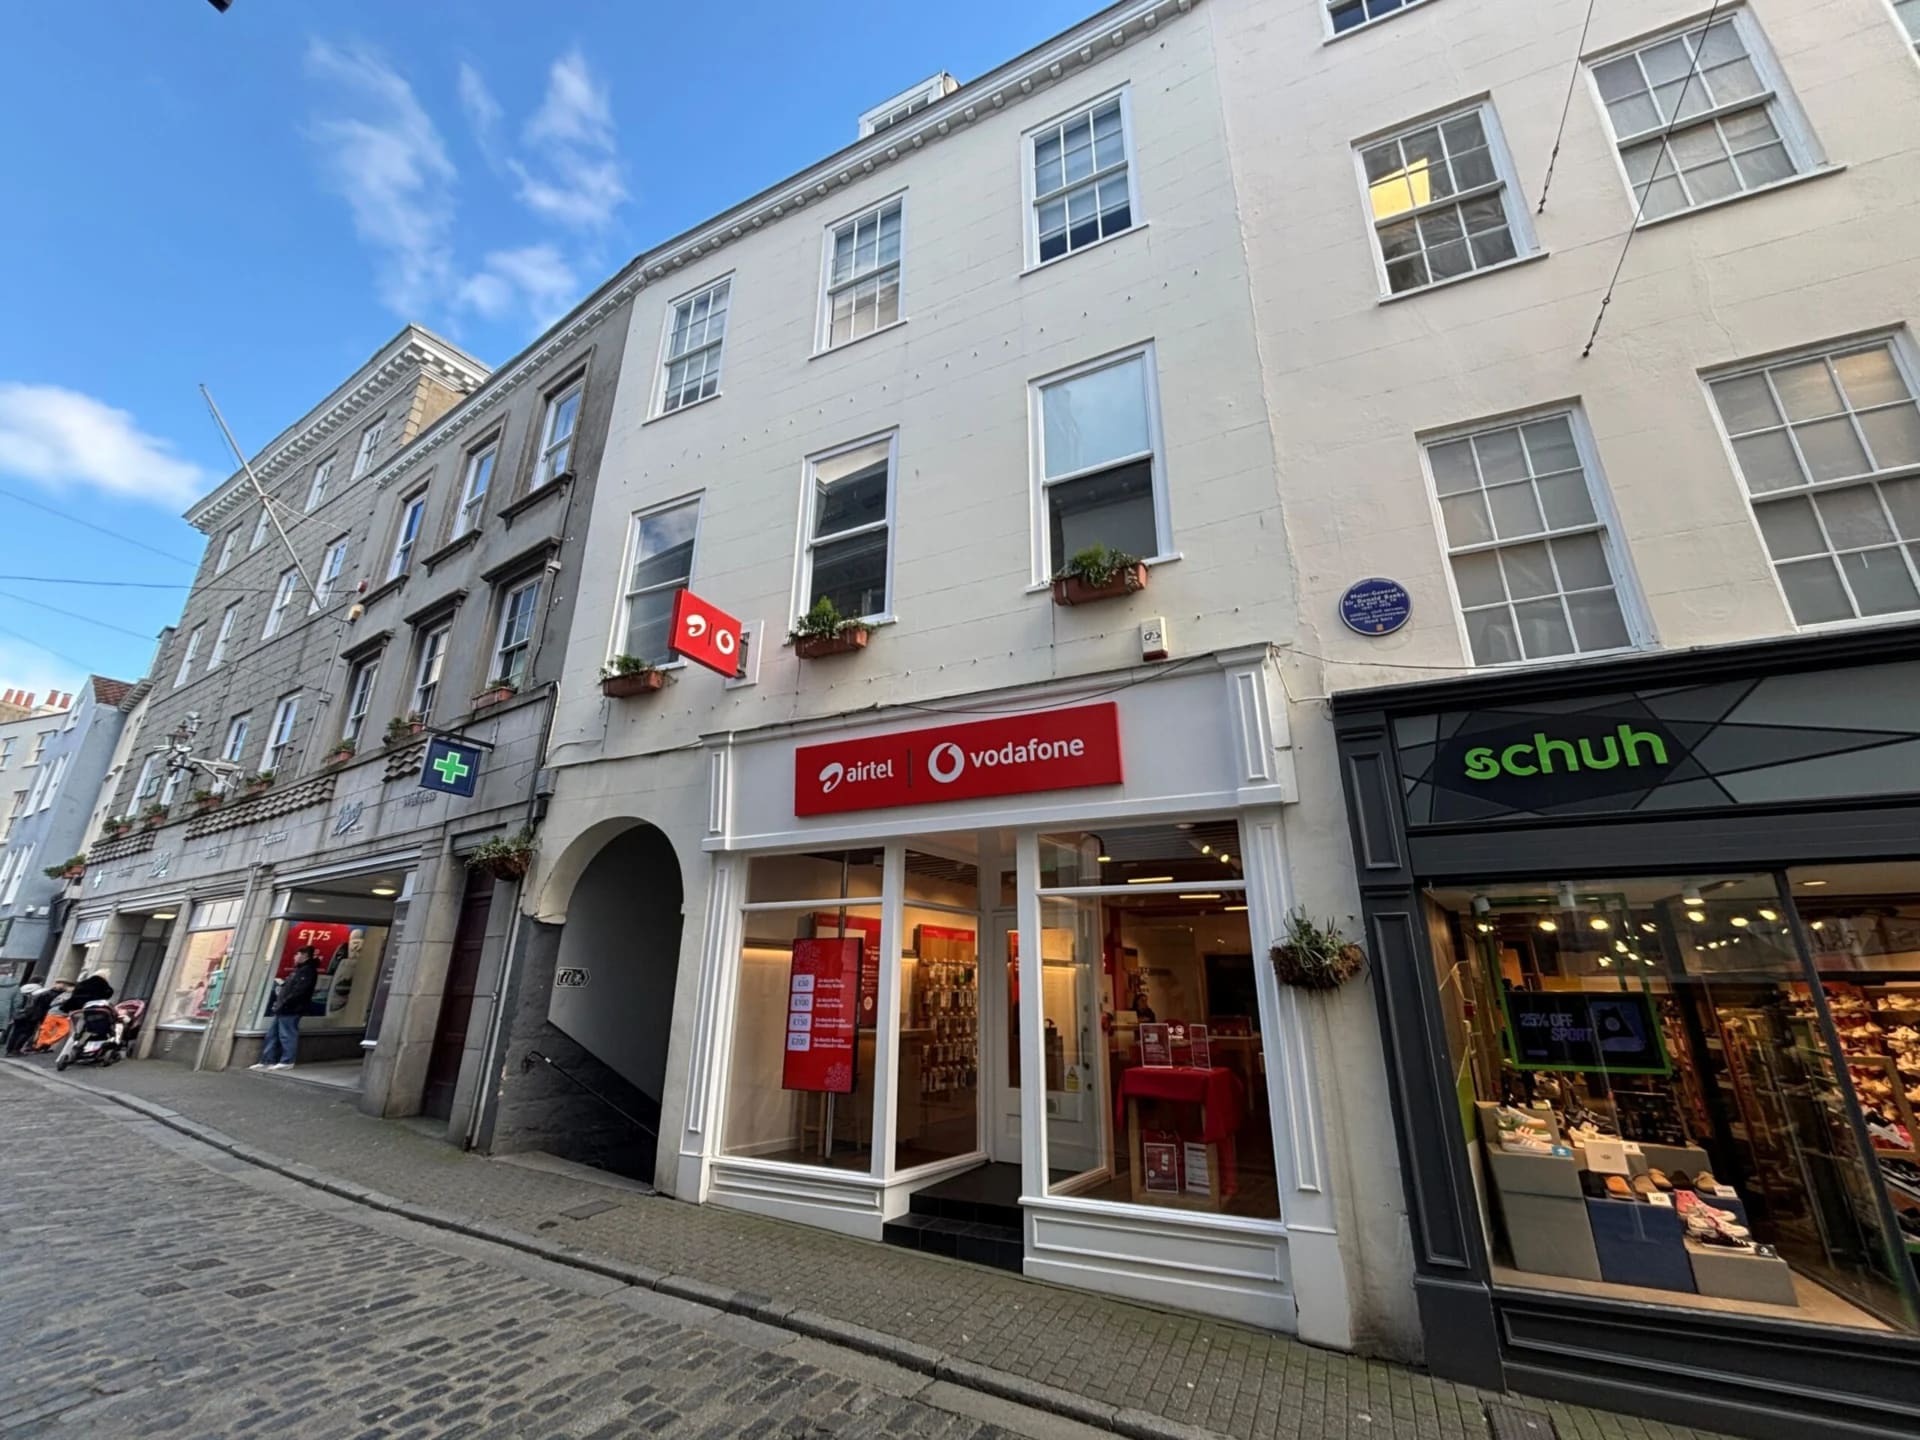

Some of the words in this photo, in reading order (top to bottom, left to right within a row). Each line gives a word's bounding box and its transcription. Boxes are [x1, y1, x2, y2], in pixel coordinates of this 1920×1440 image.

[846, 759, 894, 783] airtel
[970, 737, 1084, 769] vodafone
[1464, 724, 1668, 780] schuh
[298, 929, 331, 946] £1.75
[1550, 1012, 1573, 1027] OFF
[1551, 1027, 1593, 1042] SPORT
